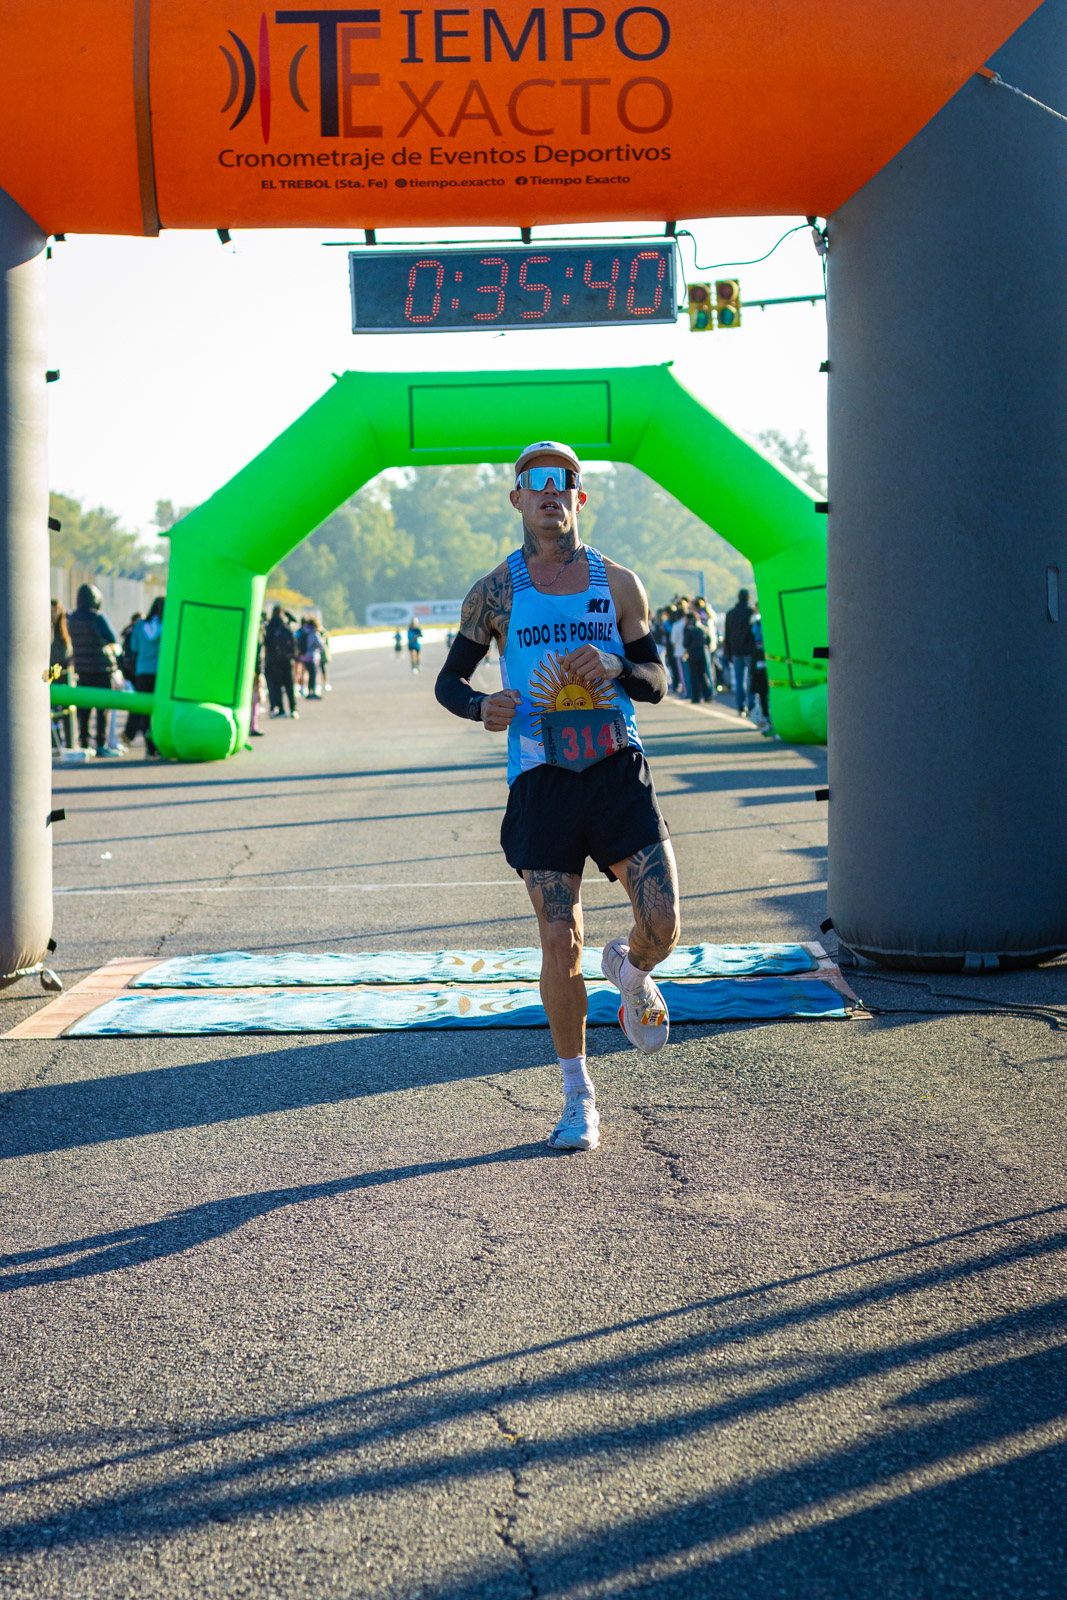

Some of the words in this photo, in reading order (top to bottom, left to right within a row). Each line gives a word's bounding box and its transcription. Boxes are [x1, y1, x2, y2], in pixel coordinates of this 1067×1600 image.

[218, 148, 385, 170] Cronometraje
[391, 147, 422, 165] de
[430, 146, 526, 165] Eventos
[534, 144, 671, 166] Deportivos
[261, 180, 277, 189] EL
[279, 179, 332, 189] TREBOL
[335, 179, 365, 189] (Sta.
[368, 178, 388, 189] Fe)
[409, 177, 505, 189] tiempo.exacto
[530, 176, 582, 187] Tiempo
[585, 174, 631, 185] Exacto
[404, 252, 665, 323] 0:35:40
[516, 624, 551, 648] TODO
[554, 623, 567, 643] ES
[570, 621, 613, 642] POSIBLE
[562, 724, 615, 761] 314
[612, 720, 624, 750] EXACT
